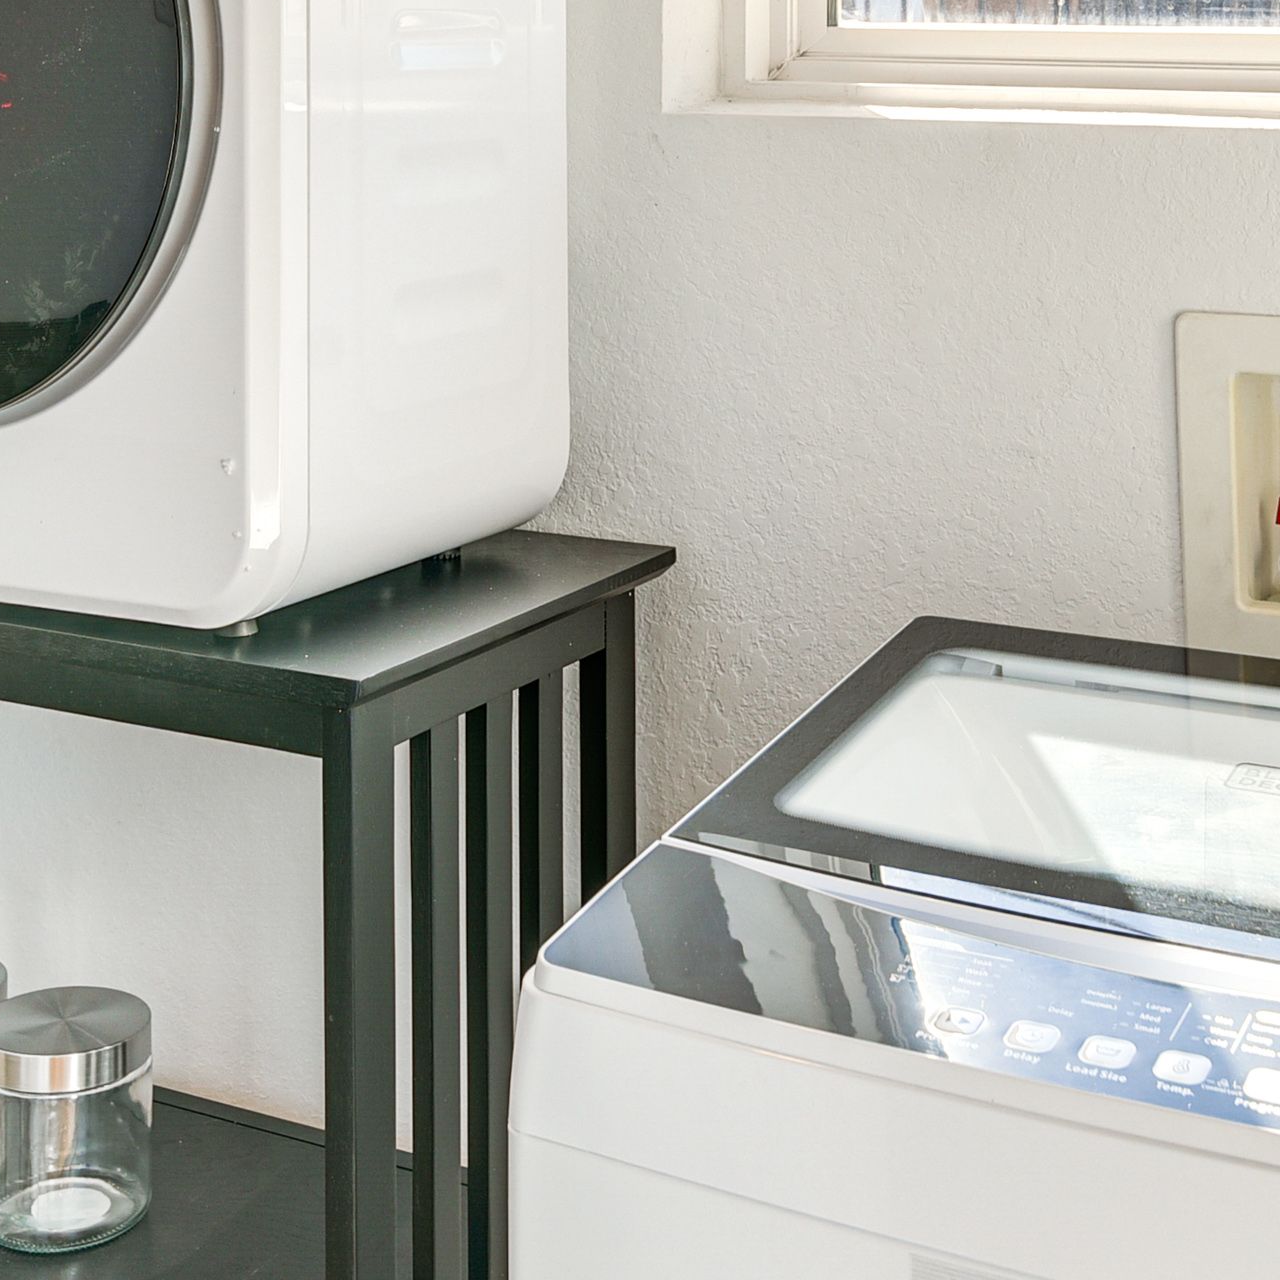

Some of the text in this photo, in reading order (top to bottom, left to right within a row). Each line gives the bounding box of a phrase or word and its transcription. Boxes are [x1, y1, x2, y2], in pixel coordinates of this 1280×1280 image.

[1145, 1002, 1172, 1013] Large
[1139, 1012, 1162, 1023] Med
[1003, 1049, 1041, 1065] Delay
[1065, 1062, 1128, 1084] Load Size
[1156, 1081, 1195, 1097] Temp.
